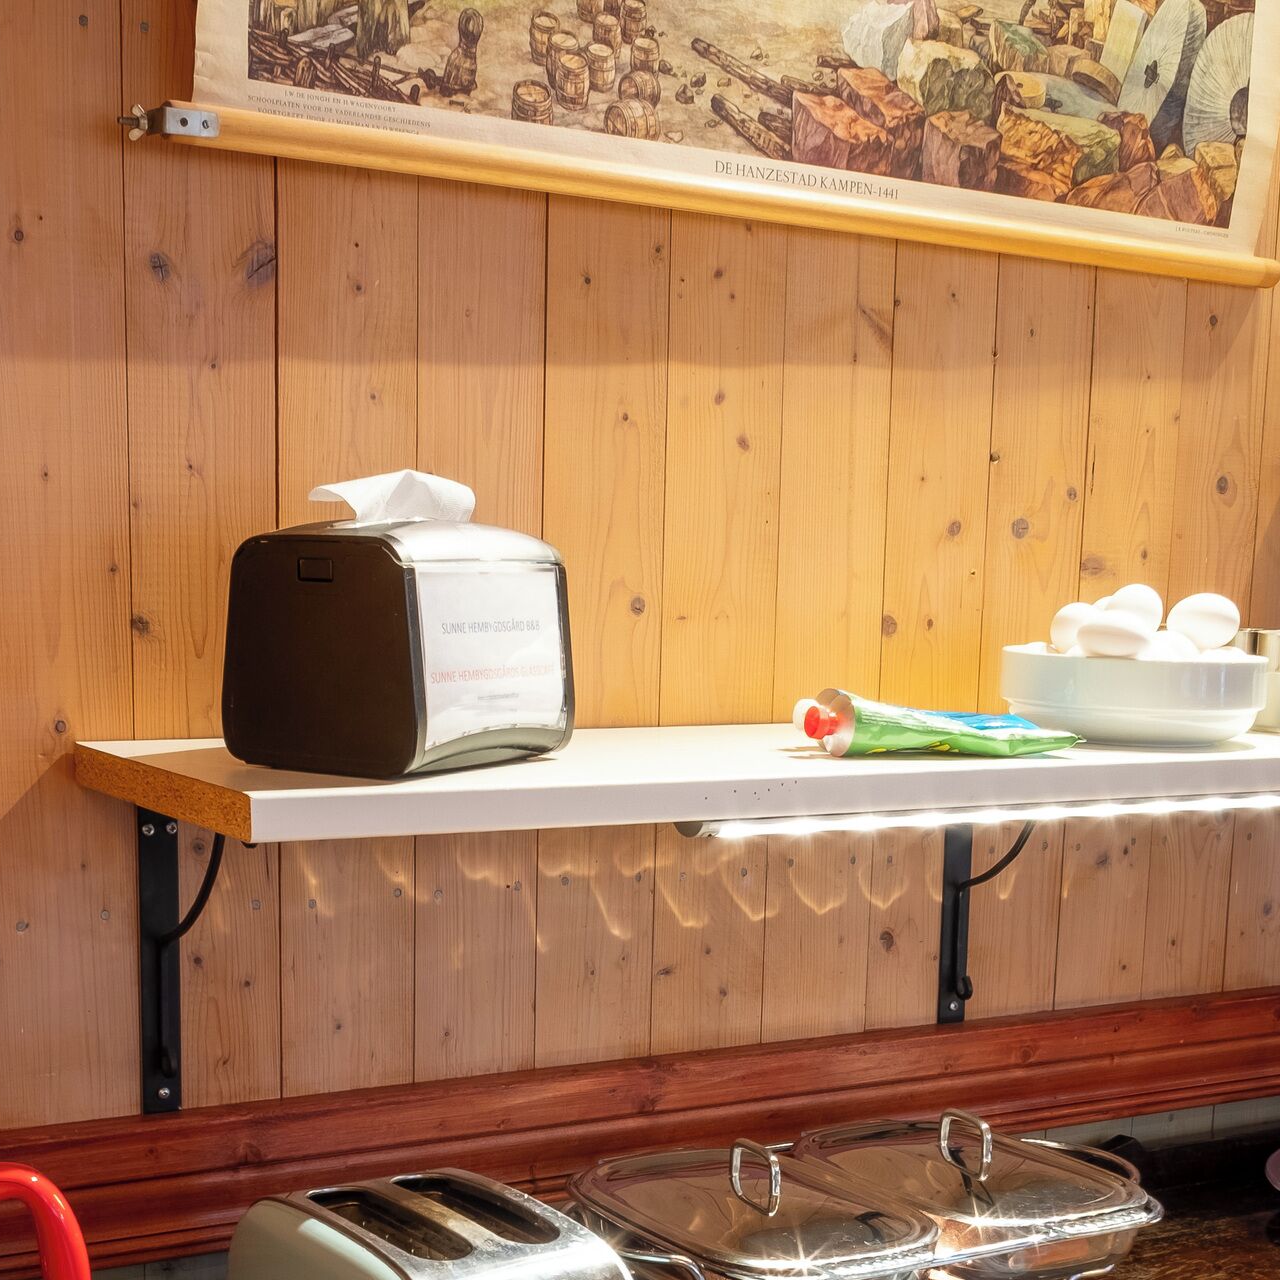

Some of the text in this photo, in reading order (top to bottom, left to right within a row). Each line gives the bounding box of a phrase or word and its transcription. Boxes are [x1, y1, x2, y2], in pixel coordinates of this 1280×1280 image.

[247, 94, 301, 110] SCHOOLPLATEN
[303, 103, 322, 113] VOOR
[324, 106, 333, 114] DE
[334, 108, 382, 122] VADERLANDSE
[383, 114, 431, 128] GESCHIEDENIS
[714, 160, 899, 200] DE HANZESTAD KAMPEN-1441
[441, 618, 541, 635] SUNNE HEMBYGDSGÅRD B&B
[430, 670, 457, 684] SUNNE
